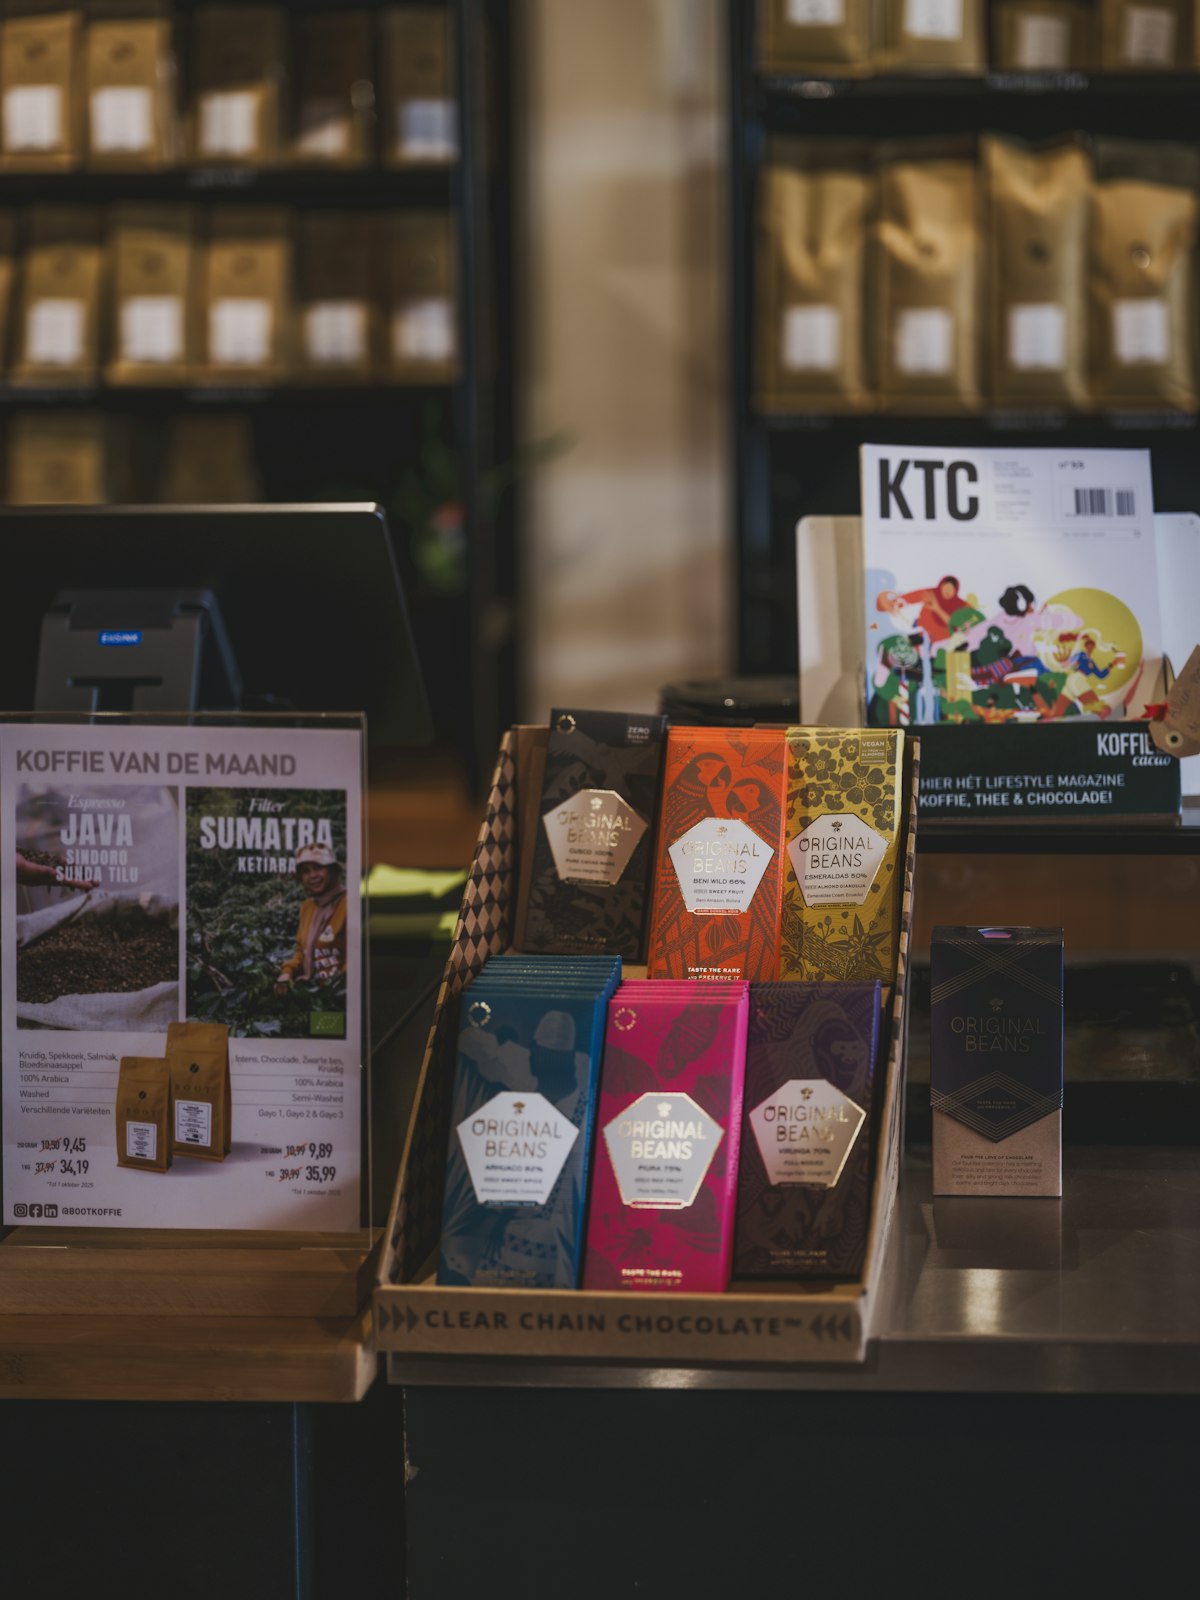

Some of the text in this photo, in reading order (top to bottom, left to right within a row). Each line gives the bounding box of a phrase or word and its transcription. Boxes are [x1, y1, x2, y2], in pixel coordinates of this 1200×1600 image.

[879, 458, 980, 522] KTC
[16, 750, 297, 777] KOFFIE VAN DE MAAND
[920, 773, 1125, 790] HIER HÉT LIFESTYLE MAGAZINE
[68, 794, 126, 811] Espresso
[249, 797, 286, 815] Filter
[919, 790, 1113, 808] KOFFIE, THEE & CHOCOLADE!
[60, 813, 134, 846] JAVA
[557, 811, 632, 831] ORIGINAL
[200, 816, 334, 851] SUMATRA
[567, 828, 620, 847] BEANS
[682, 840, 759, 857] ORIGINAL
[799, 836, 874, 852] ORIGINAL
[66, 849, 128, 865] SINDORO
[693, 857, 748, 874] BEANS
[810, 853, 862, 868] BEANS
[56, 865, 139, 883] SUNDA TILU
[951, 1016, 1046, 1034] ORIGINAL
[965, 1035, 1030, 1053] BEANS
[19, 1060, 83, 1070] Bloedsinaasappel
[20, 1074, 69, 1083] 100% Arabica
[295, 1078, 344, 1087] 100% Arabica
[19, 1090, 49, 1098] Washed
[292, 1093, 344, 1103] Semi-Washed
[21, 1105, 70, 1114] Verschillende
[258, 1109, 277, 1119] Gayo
[286, 1109, 304, 1119] Gayo
[305, 1110, 311, 1118] 2
[312, 1110, 318, 1118] &
[319, 1110, 338, 1120] Gayo
[339, 1111, 344, 1119] 3
[764, 1105, 849, 1122] ORIGINAL
[471, 1118, 562, 1139] ORIGINAL
[618, 1120, 707, 1140] ORIGINAL
[776, 1125, 834, 1142] BEANS
[63, 1137, 86, 1154] 9,45
[308, 1142, 333, 1160] 9,89
[484, 1140, 548, 1159] BEANS
[631, 1140, 694, 1160] BEANS
[60, 1160, 89, 1176] 34,19
[305, 1165, 337, 1183] 35,99
[62, 1207, 122, 1216] @BOOTKOFFIE
[425, 1310, 509, 1329] CLEAR
[519, 1311, 606, 1332] CHAIN
